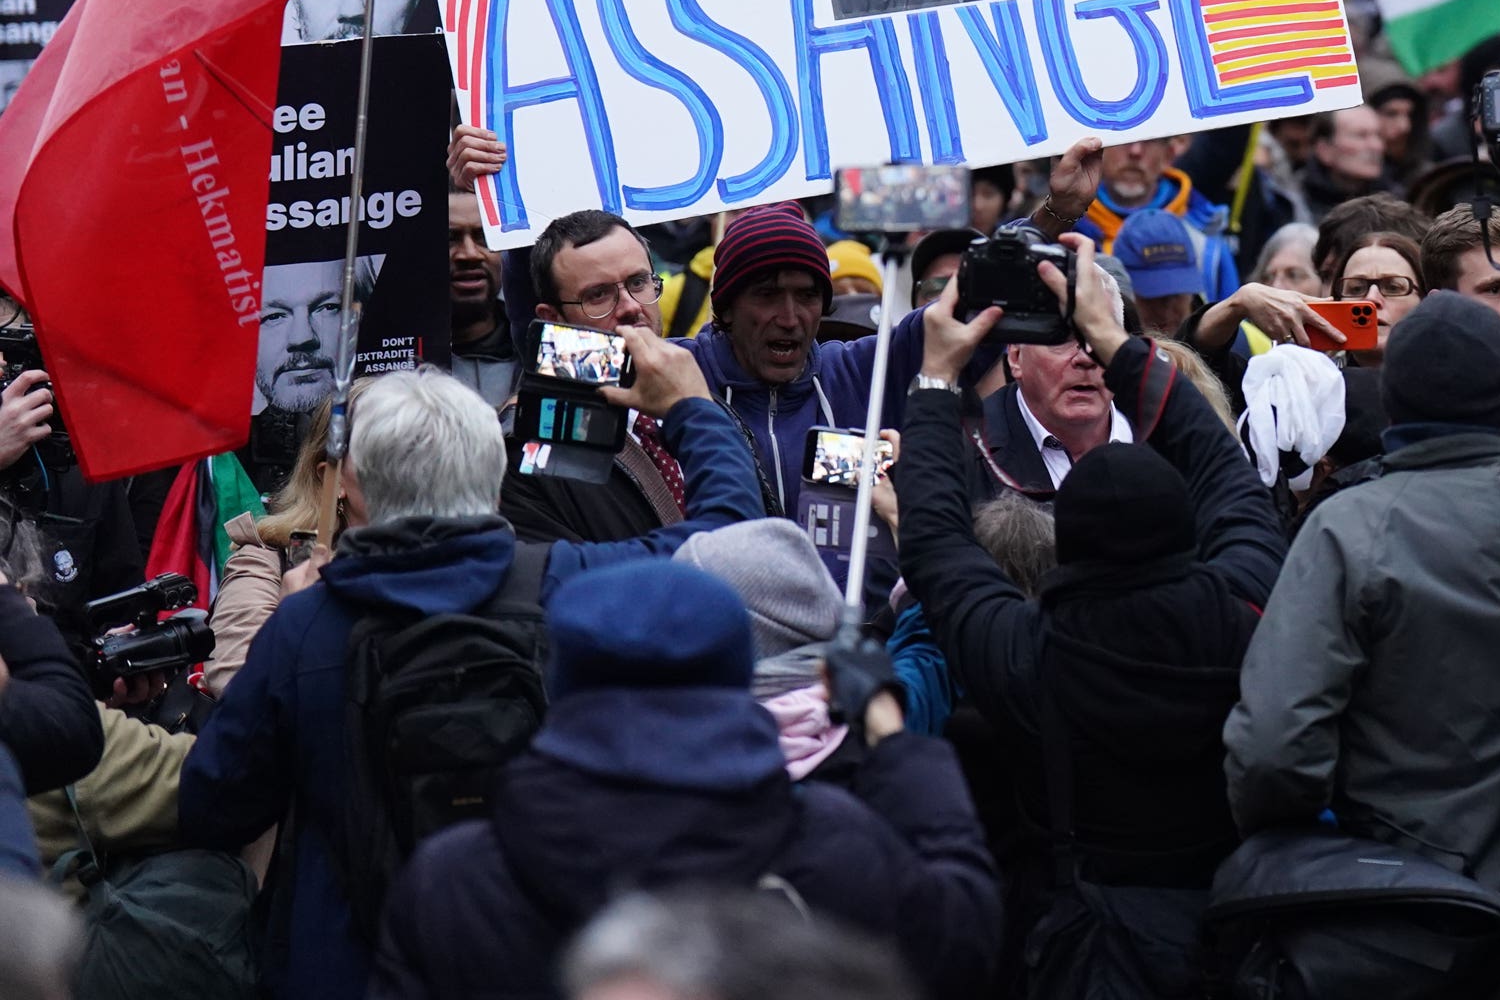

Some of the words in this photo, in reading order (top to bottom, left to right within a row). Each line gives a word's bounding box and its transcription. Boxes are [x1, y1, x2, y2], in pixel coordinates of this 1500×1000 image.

[273, 102, 326, 133] ee
[265, 189, 422, 231] ssange
[180, 136, 262, 328] Hekmatist
[382, 336, 415, 348] DON'T
[357, 348, 415, 362] EXTRADITE
[365, 359, 415, 373] ASSANGE
